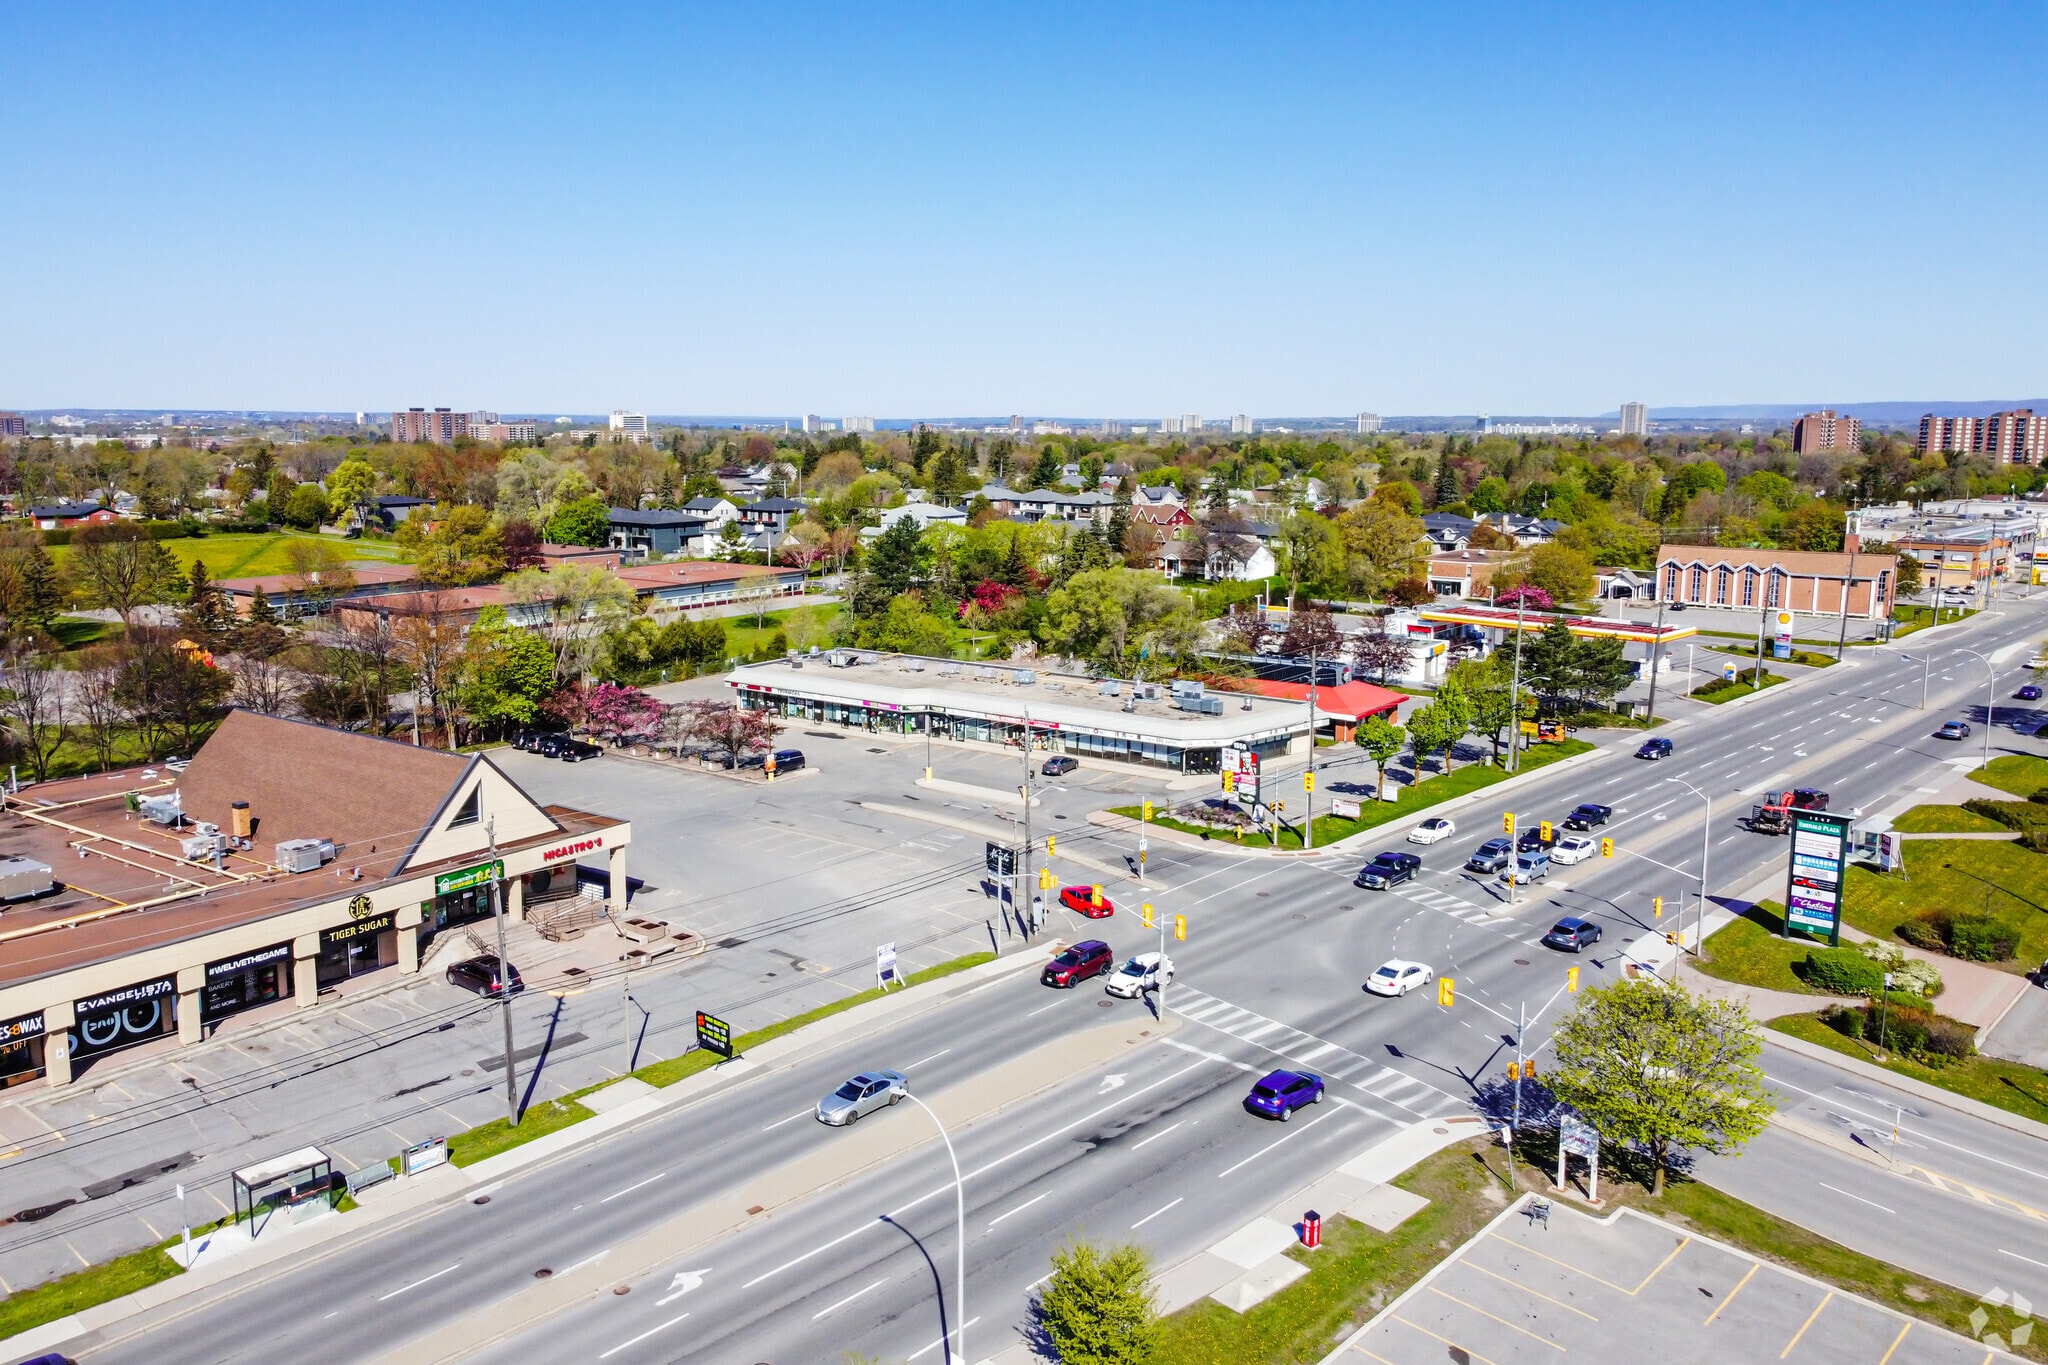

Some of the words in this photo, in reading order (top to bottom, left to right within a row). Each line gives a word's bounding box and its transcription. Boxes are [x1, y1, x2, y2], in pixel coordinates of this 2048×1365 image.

[1822, 825, 1841, 833] PLAZA
[543, 837, 603, 862] NICASTRO'S
[329, 927, 357, 942] TIGER
[358, 917, 389, 934] SUGAR
[208, 946, 289, 977] #WELIVETHEGAME
[77, 980, 172, 1013] EVANGELISTA
[208, 980, 234, 992] BAKERY
[19, 1016, 43, 1035] WAX
